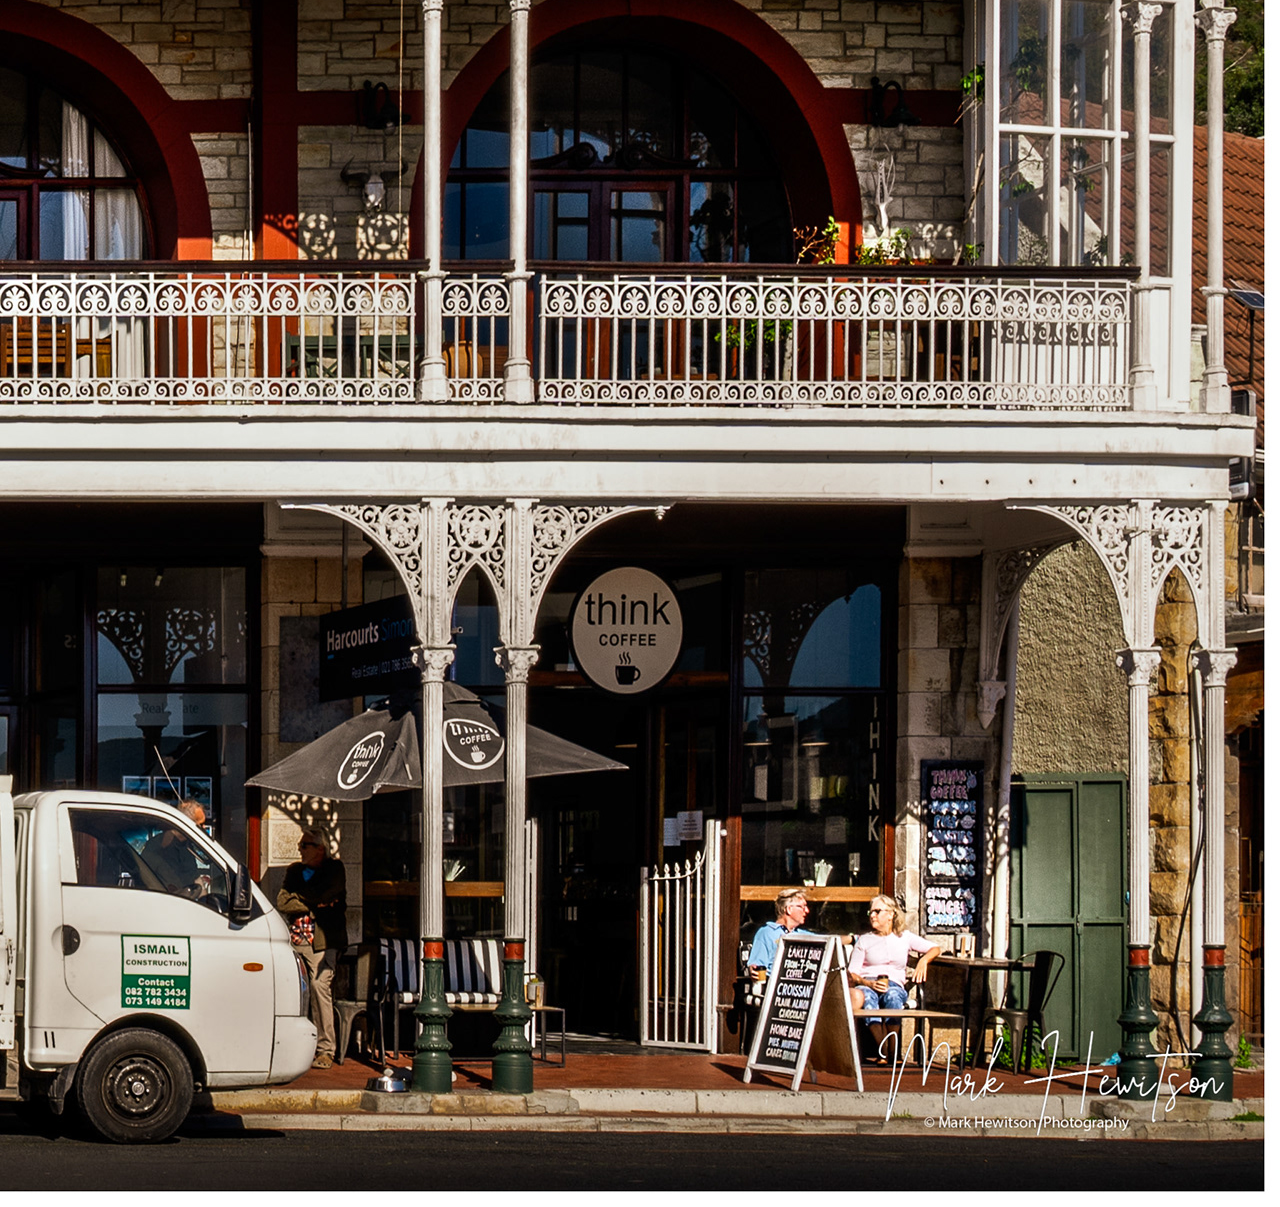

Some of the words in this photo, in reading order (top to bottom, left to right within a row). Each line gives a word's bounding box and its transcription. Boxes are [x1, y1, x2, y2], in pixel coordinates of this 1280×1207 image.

[584, 592, 671, 625] think
[326, 622, 379, 653] Harcourts
[599, 633, 657, 647] COFFEE
[459, 733, 492, 746] COFFEE
[930, 785, 968, 800] COFFEE
[134, 944, 179, 955] ISMAIL
[125, 959, 187, 967] CONSTRUCTION
[138, 977, 175, 986] Contact
[125, 987, 143, 996] 082
[144, 987, 162, 996] 782
[164, 988, 187, 997] 3434
[125, 996, 143, 1005] 073
[145, 997, 162, 1006] 149
[164, 998, 187, 1007] 4184
[770, 1024, 789, 1037] HOME
